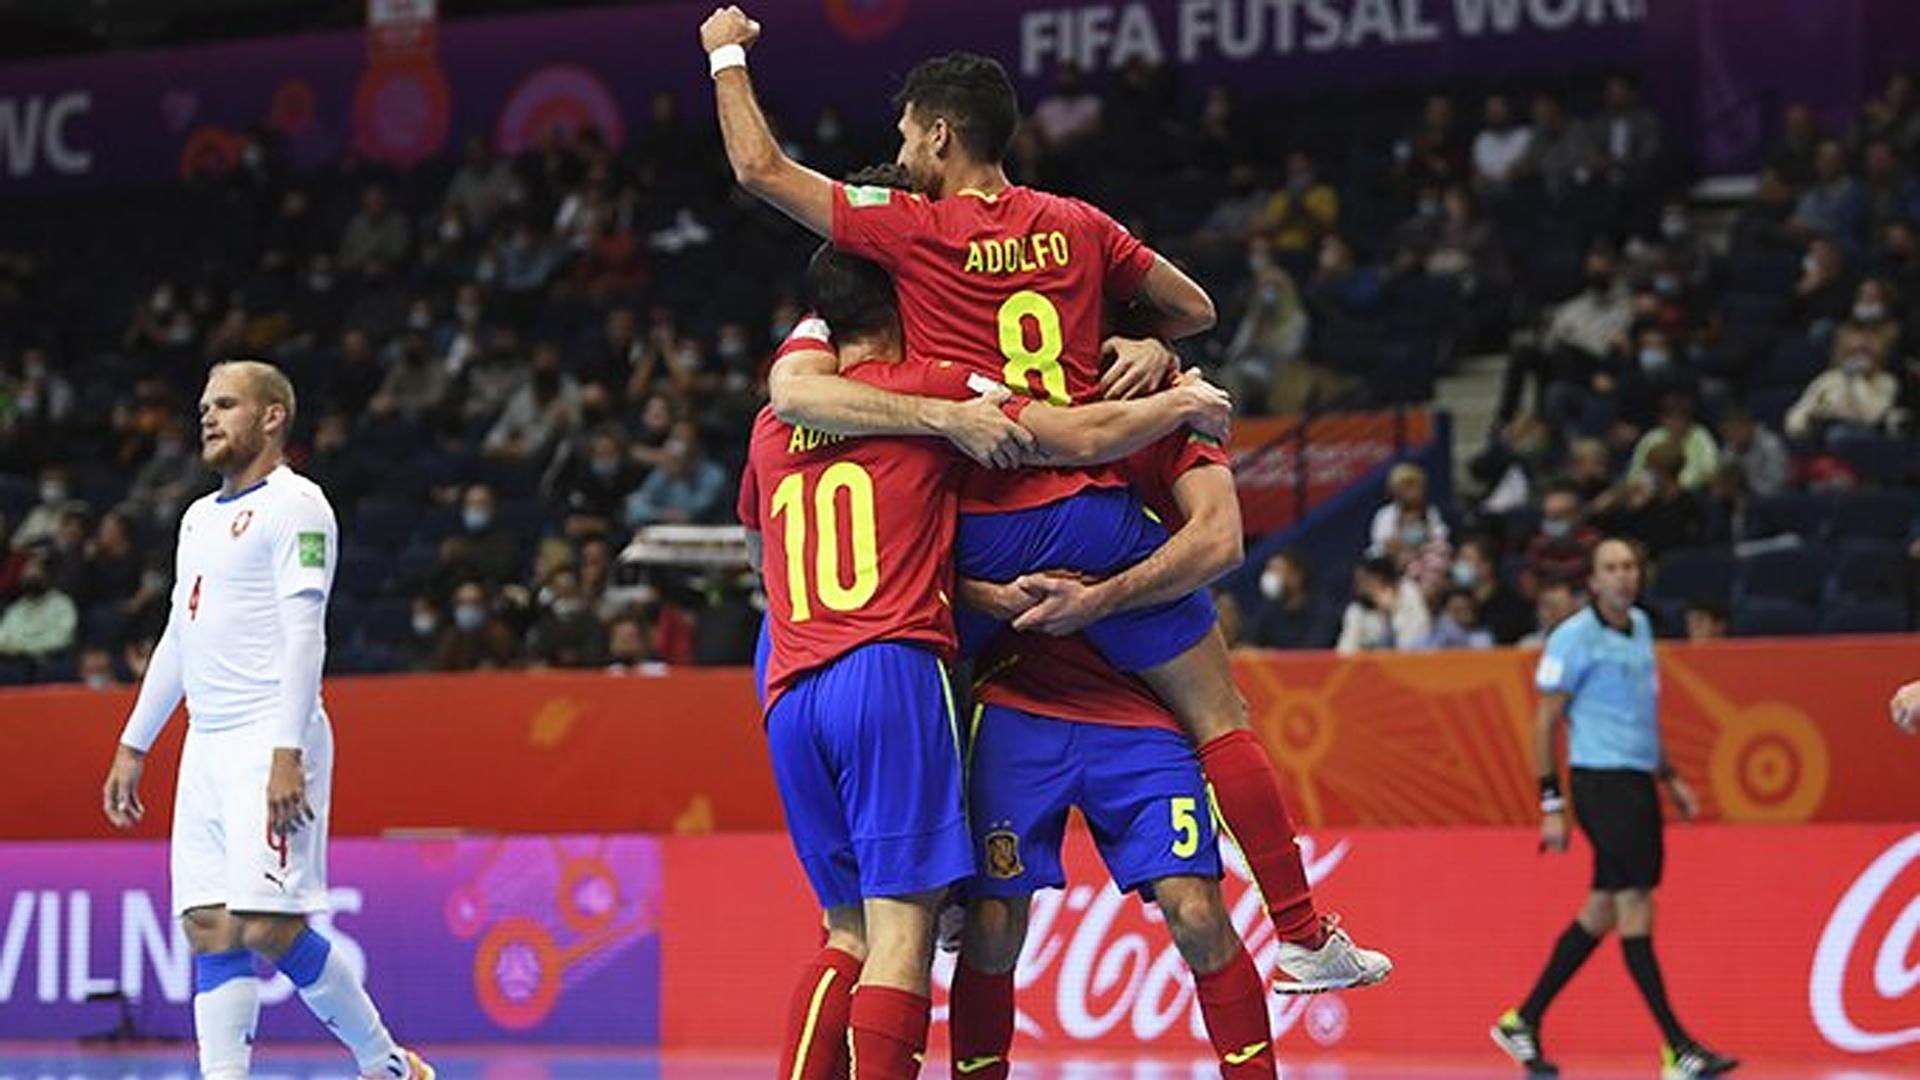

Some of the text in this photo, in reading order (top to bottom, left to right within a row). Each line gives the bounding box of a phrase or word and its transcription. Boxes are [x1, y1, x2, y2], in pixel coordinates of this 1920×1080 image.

[1021, 5, 1163, 76] FIFA
[1177, 0, 1439, 63] FUTSAL
[964, 231, 1069, 273] ADOLFO
[998, 290, 1072, 407] 8
[770, 461, 880, 622] 10
[189, 575, 203, 622] 4
[1171, 797, 1199, 859] 5
[0, 888, 368, 1004] VILNS
